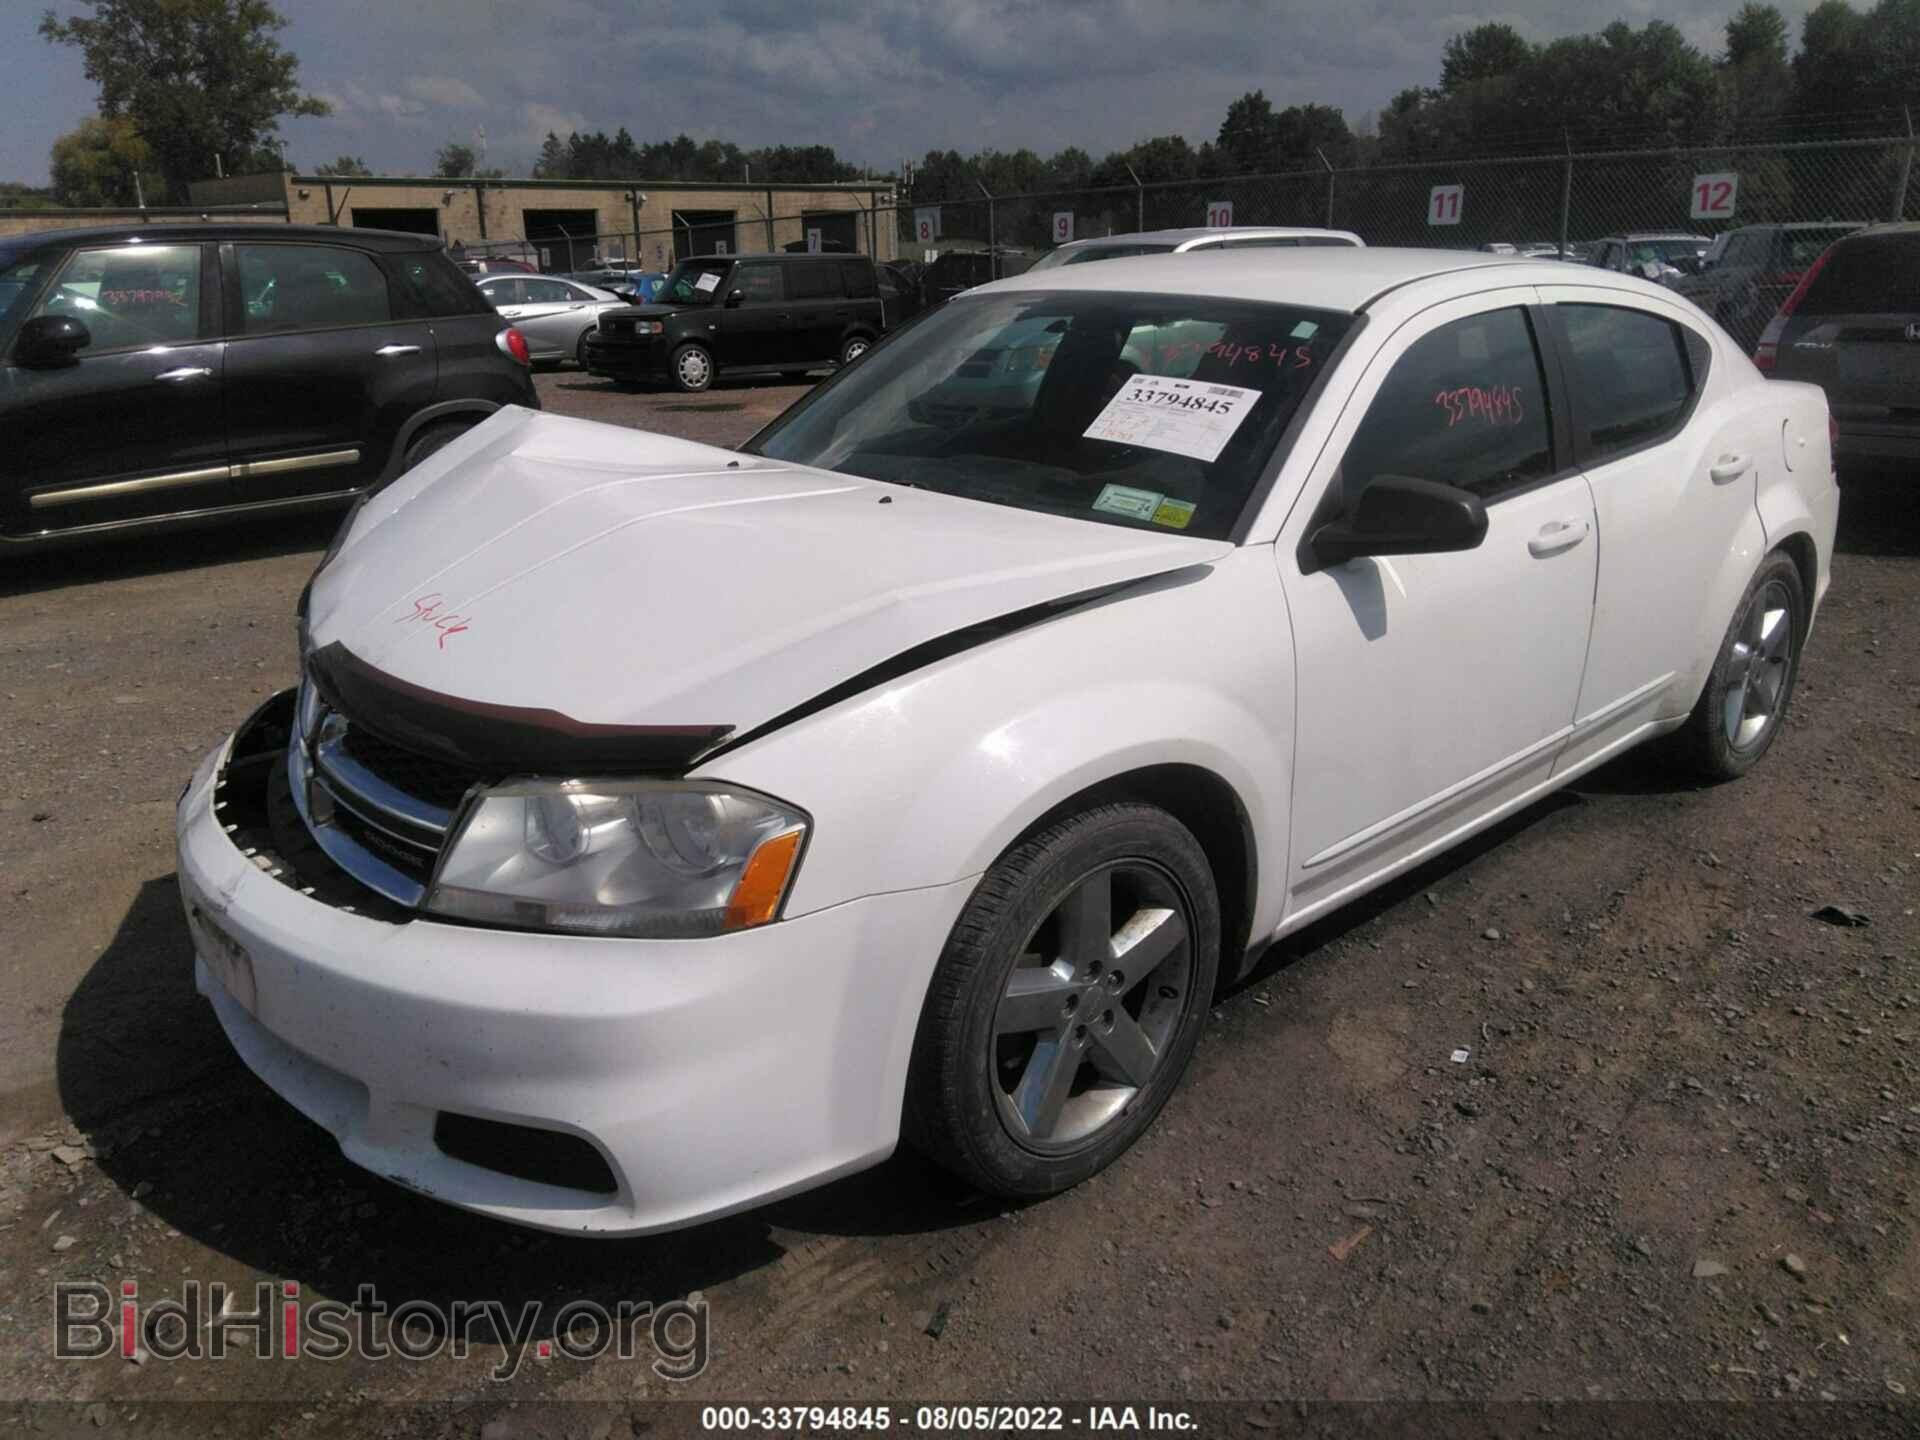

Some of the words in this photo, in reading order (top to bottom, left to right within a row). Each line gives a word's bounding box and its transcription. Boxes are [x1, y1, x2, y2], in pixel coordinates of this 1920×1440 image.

[1433, 193, 1459, 218] 11
[1697, 182, 1733, 212] 12
[920, 221, 929, 239] 8
[1057, 217, 1069, 236] 9
[1209, 208, 1229, 227] 10
[1126, 387, 1233, 415] 33794845
[1434, 385, 1523, 427] 33794845
